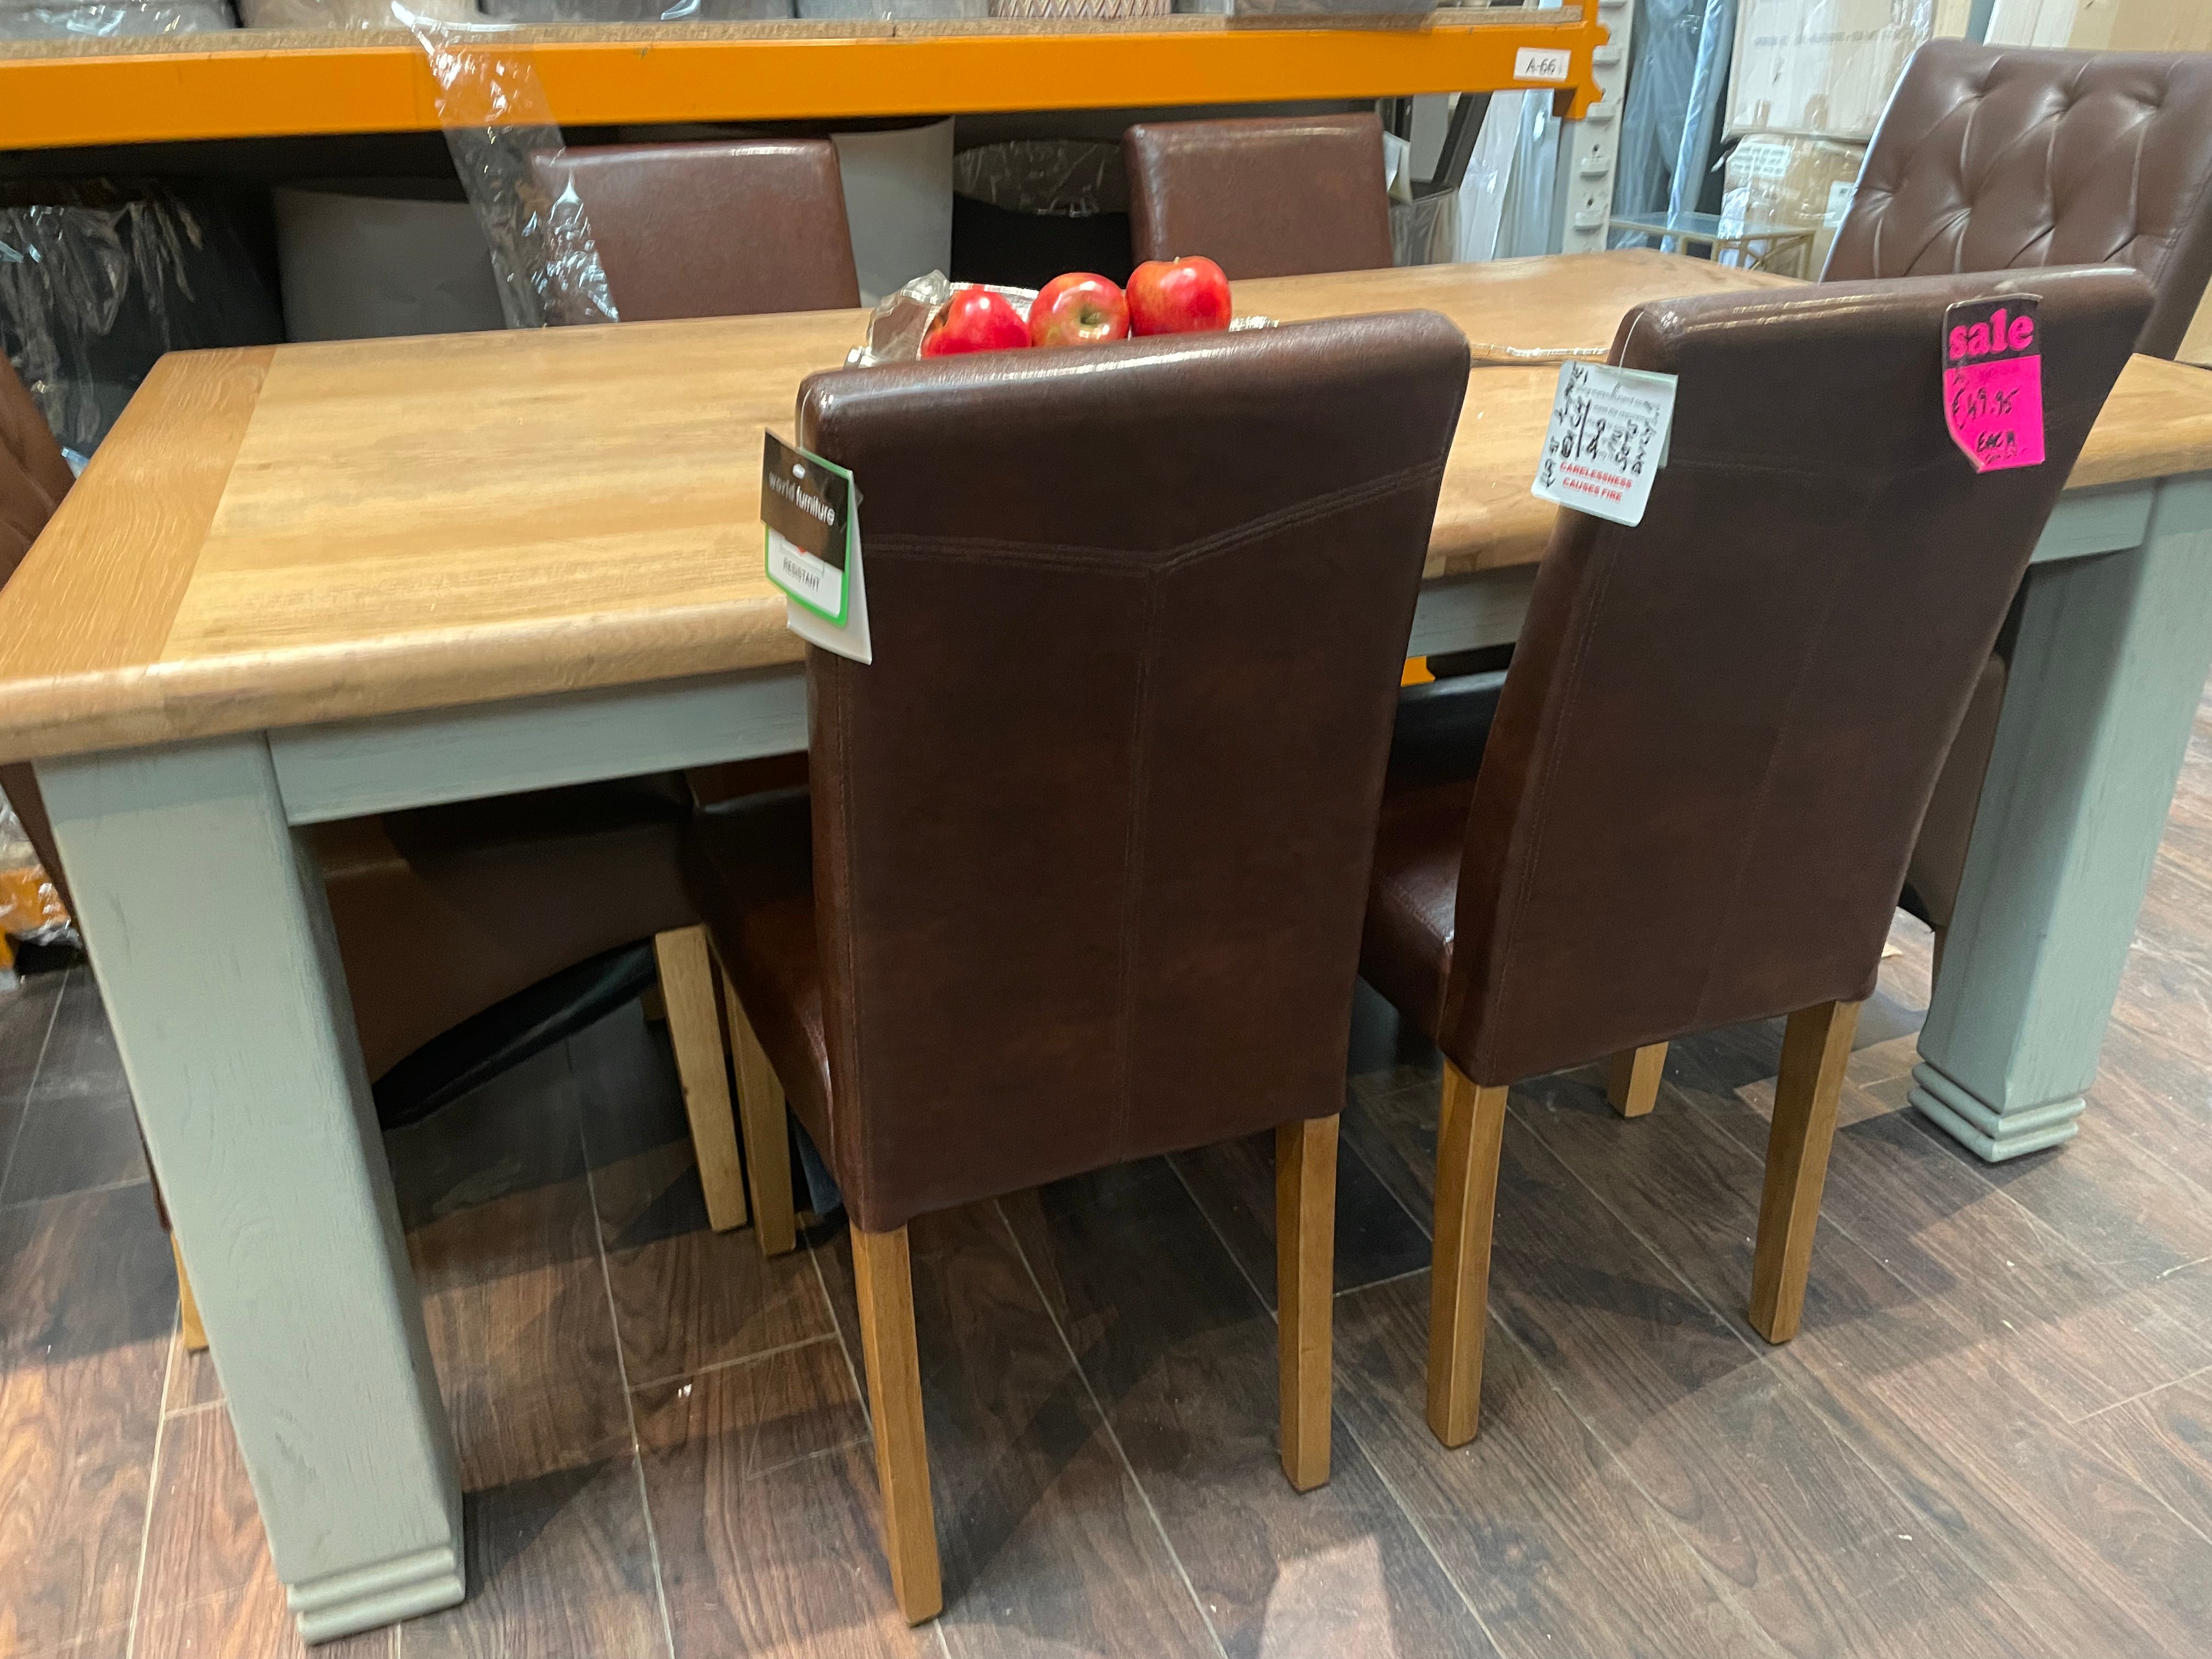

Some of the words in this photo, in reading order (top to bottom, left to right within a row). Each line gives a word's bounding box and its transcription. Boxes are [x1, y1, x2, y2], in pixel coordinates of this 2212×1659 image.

[1949, 308, 2034, 360] sale
[1560, 461, 1632, 488] CARELESSNESS
[1563, 477, 1600, 495] CAUSES
[1601, 488, 1622, 501] FIRE
[769, 472, 795, 501] world
[795, 486, 835, 526] furniture
[783, 557, 821, 592] RESISTANT
